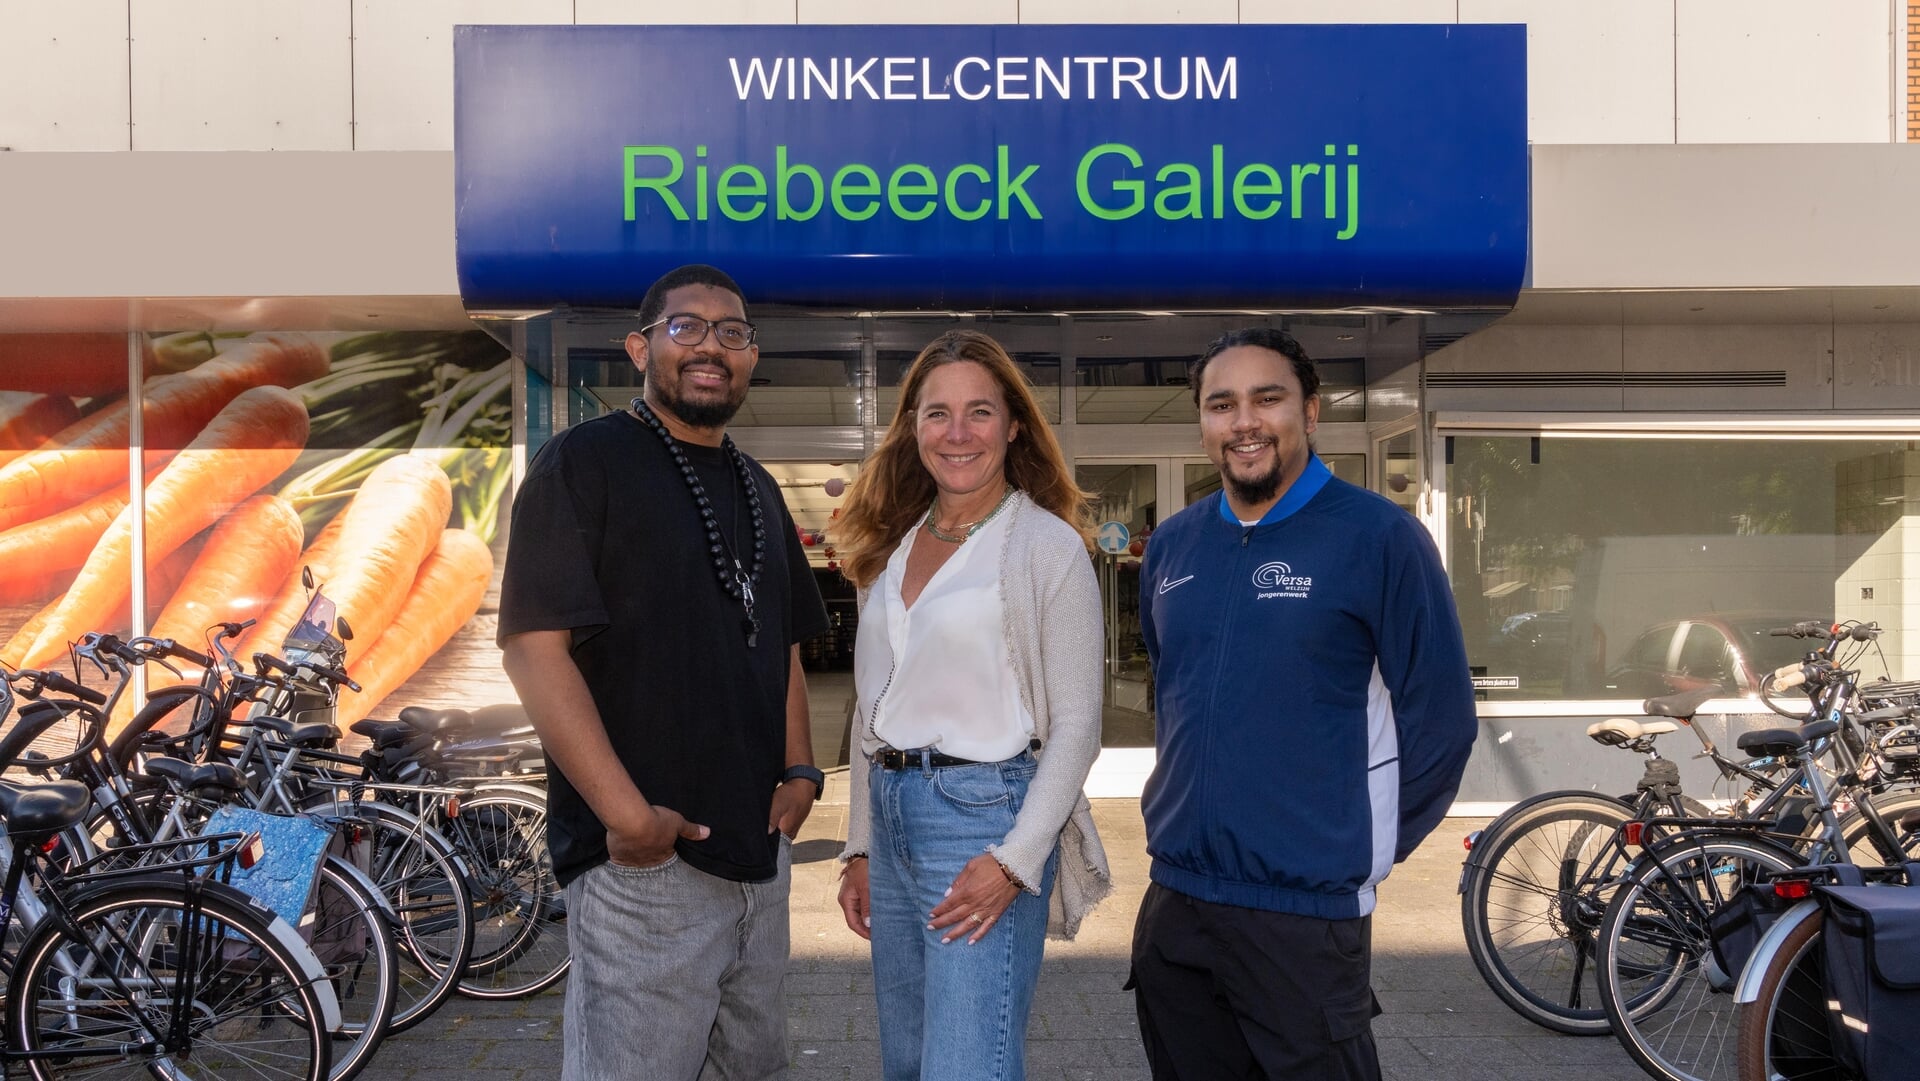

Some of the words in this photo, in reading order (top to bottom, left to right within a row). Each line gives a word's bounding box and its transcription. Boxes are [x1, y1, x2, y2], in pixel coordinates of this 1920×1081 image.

[729, 57, 1237, 100] WINKELCENTRUM
[623, 145, 1042, 221] Riebeeck
[1076, 144, 1358, 240] Galerij
[1257, 592, 1308, 600] jongerenwerk
[1275, 574, 1312, 586] Versa
[112, 804, 139, 845] Gaz
